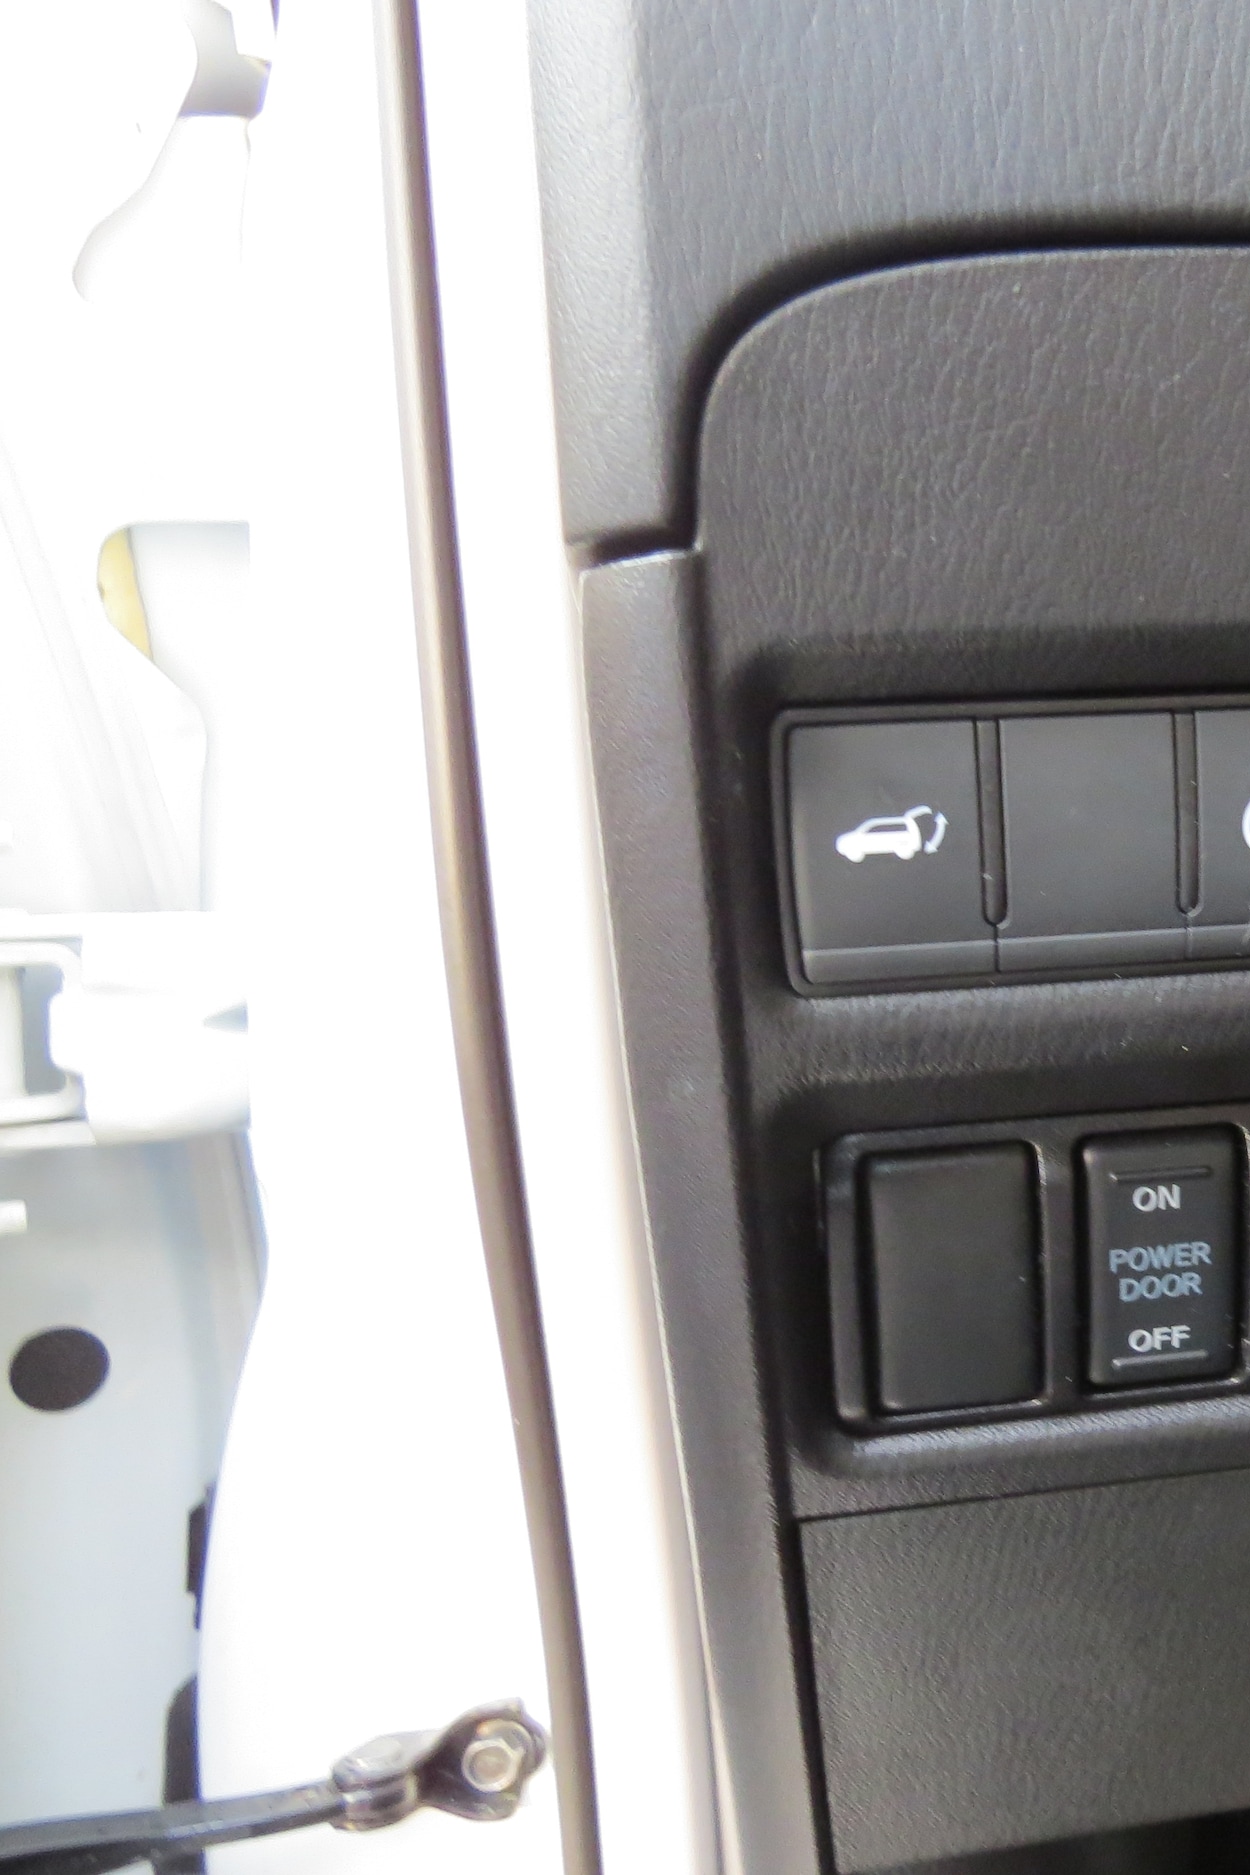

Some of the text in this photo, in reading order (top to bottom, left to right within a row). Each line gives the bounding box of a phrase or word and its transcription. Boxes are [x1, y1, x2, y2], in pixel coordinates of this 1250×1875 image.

[1132, 1184, 1182, 1212] ON
[1108, 1241, 1213, 1274] POWER
[1118, 1272, 1203, 1302] DOOR
[1127, 1325, 1192, 1353] OFF
